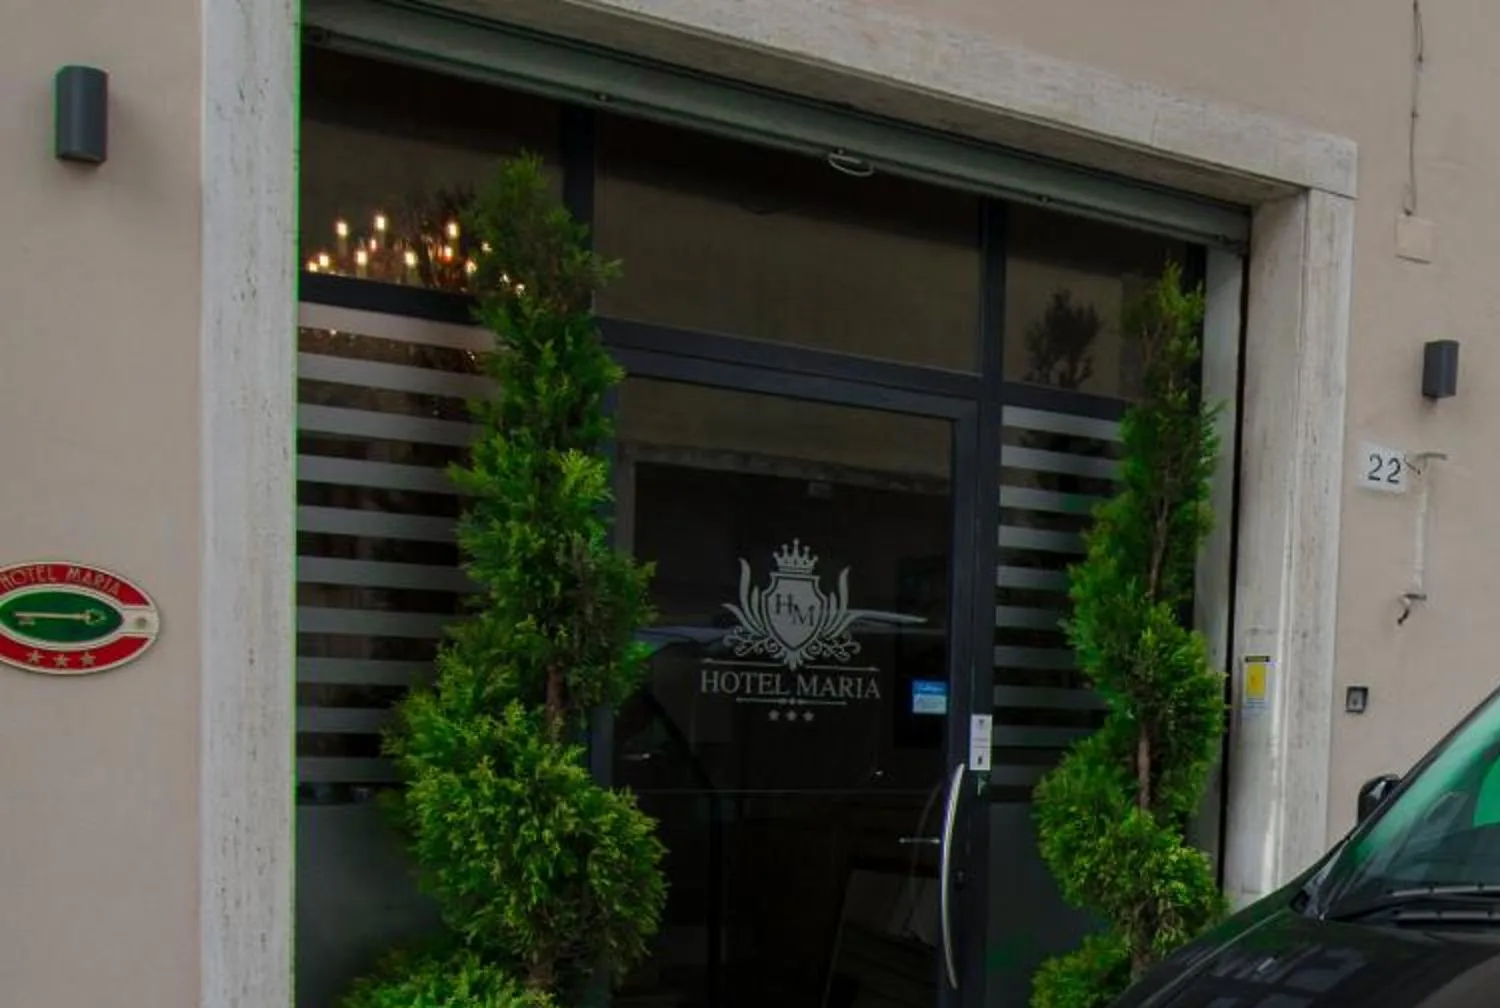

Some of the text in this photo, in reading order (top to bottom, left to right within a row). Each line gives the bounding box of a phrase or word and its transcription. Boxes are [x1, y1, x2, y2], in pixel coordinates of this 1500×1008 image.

[1368, 453, 1401, 485] 22
[1, 565, 121, 596] HOTEL MARIA
[700, 669, 881, 700] HOTEL MARIA
